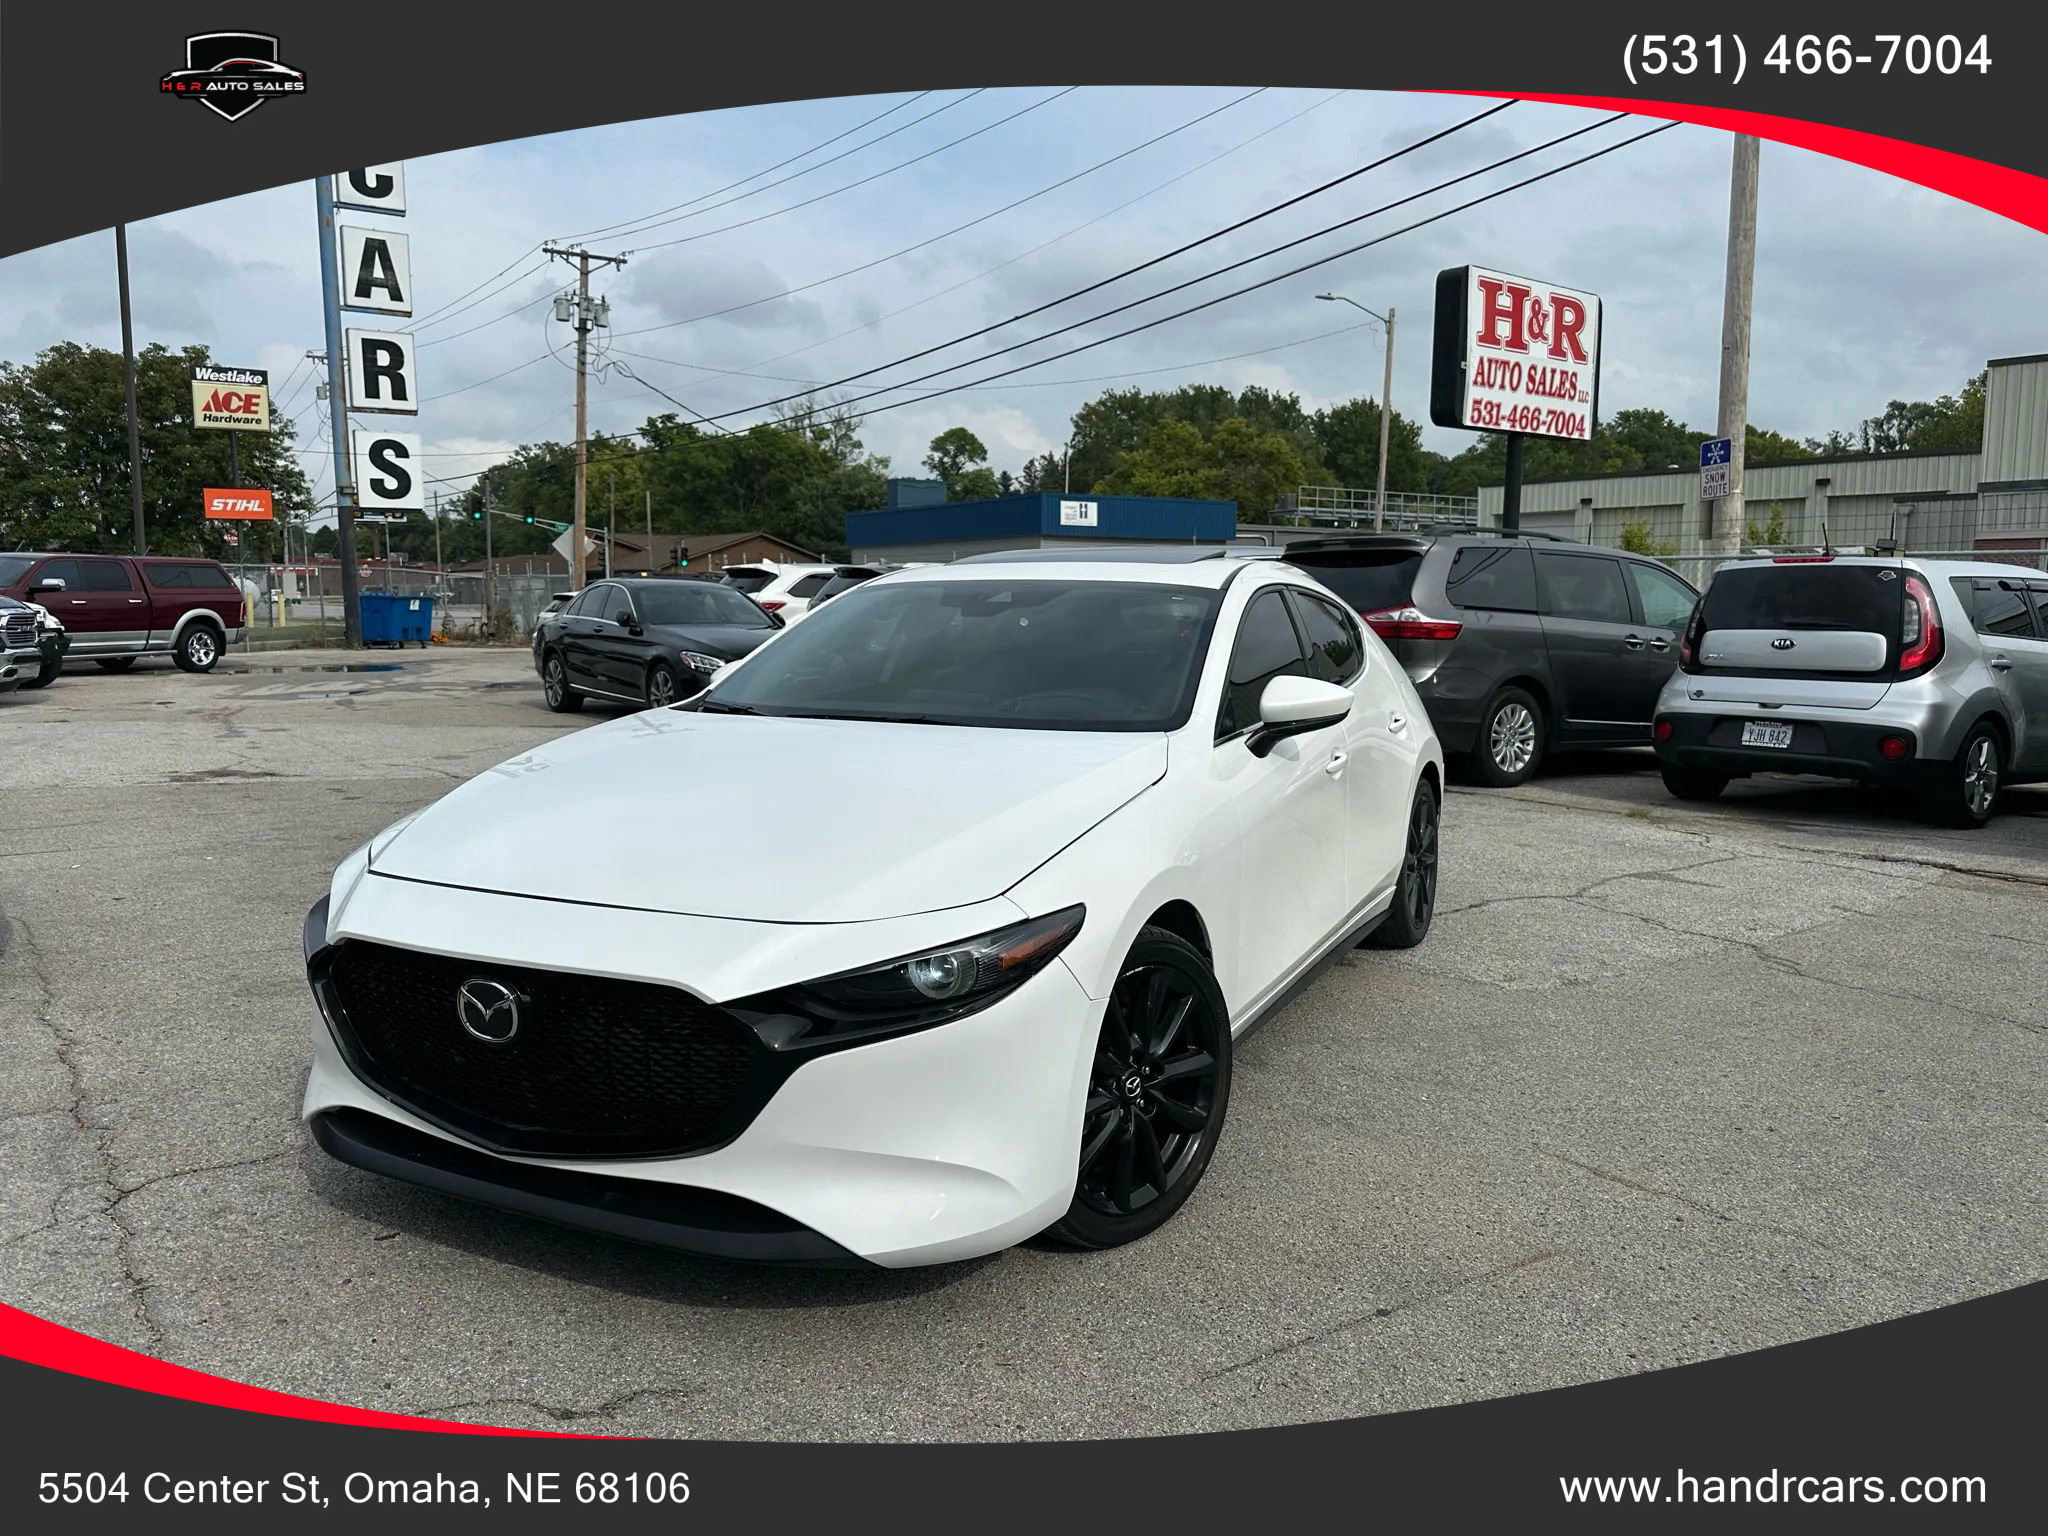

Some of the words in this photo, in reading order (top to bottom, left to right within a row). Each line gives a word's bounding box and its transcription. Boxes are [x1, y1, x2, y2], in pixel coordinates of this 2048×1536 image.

[195, 367, 263, 384] Westlake
[1472, 355, 1522, 393] AUTO
[1525, 363, 1578, 400] SALES
[1577, 389, 1590, 404] LLC
[202, 388, 261, 415] ACE
[203, 413, 262, 425] Hardware
[1470, 396, 1586, 438] 531-466-7004
[1704, 471, 1726, 485] SNOW
[1702, 483, 1728, 496] ROUTE
[211, 499, 265, 512] STIHL
[1773, 639, 1791, 648] KIA
[1749, 728, 1767, 742] YJH
[1768, 730, 1788, 744] 842
